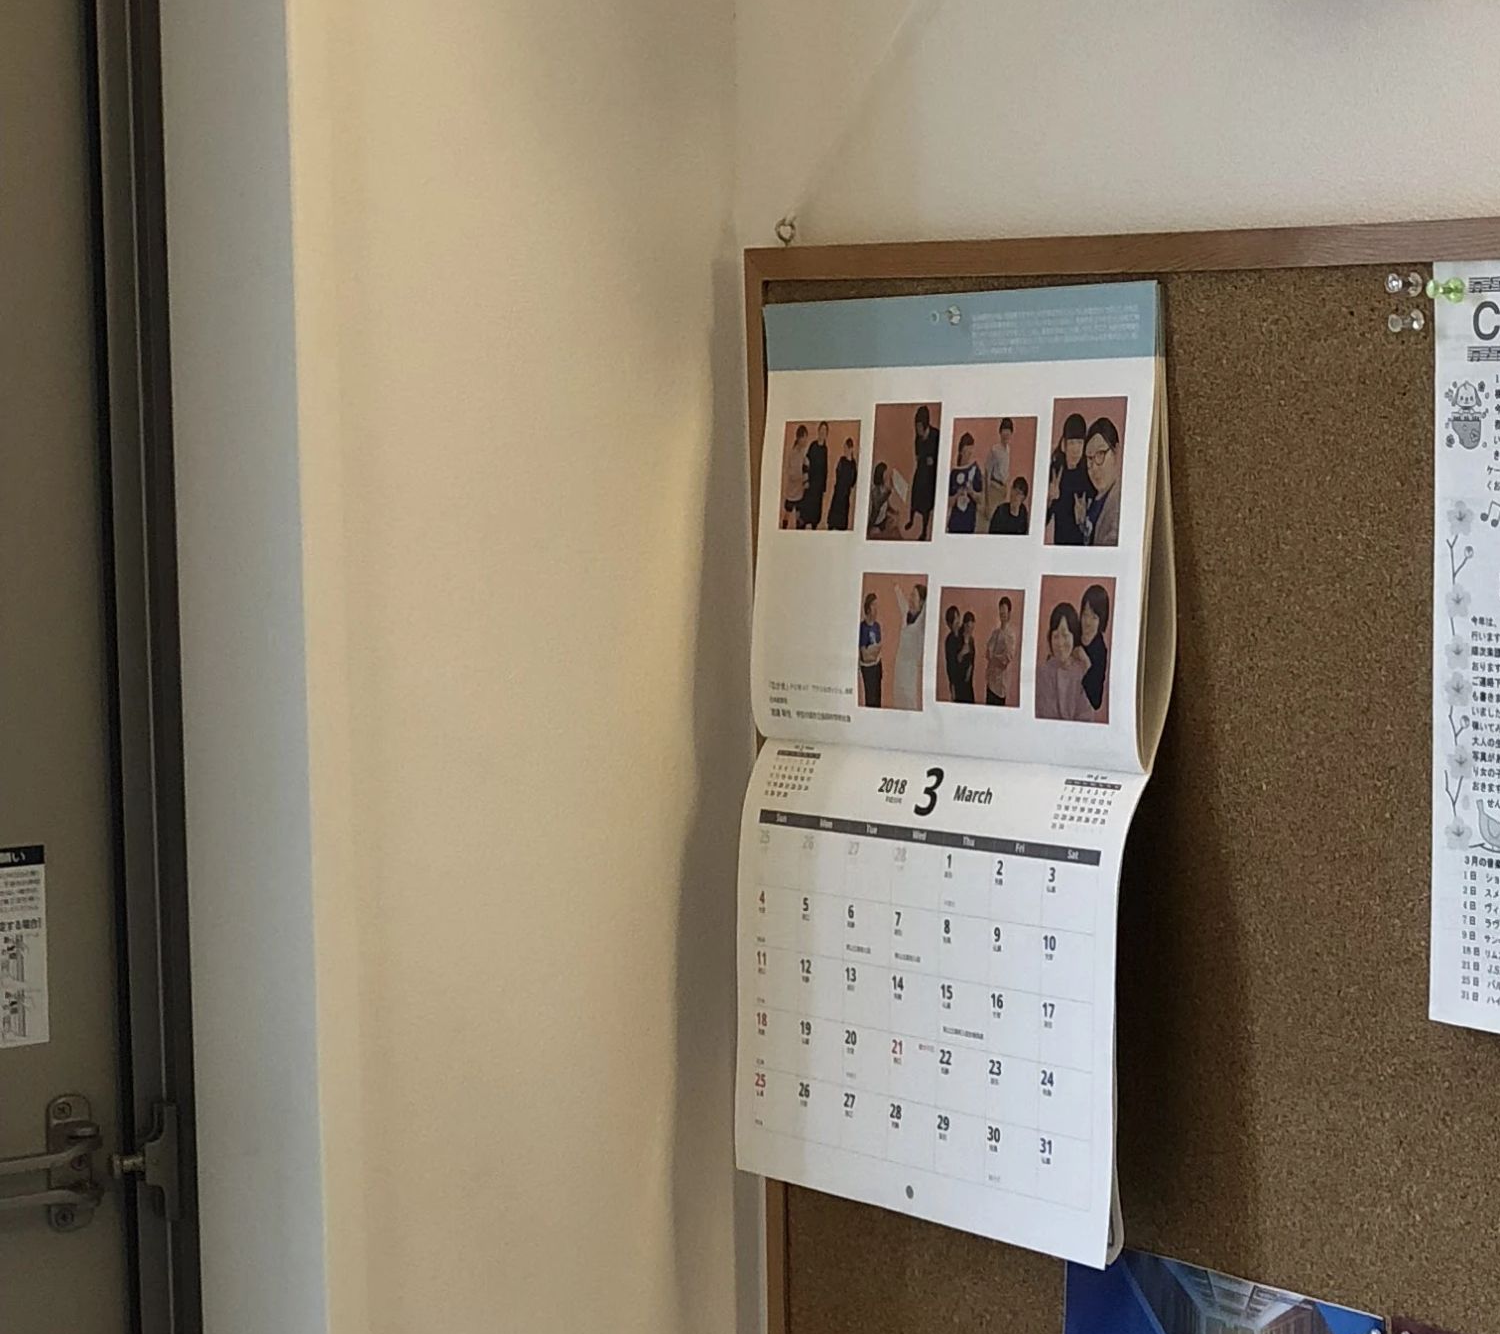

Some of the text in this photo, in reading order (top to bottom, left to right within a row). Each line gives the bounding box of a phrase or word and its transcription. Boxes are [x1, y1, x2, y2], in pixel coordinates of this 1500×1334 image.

[878, 767, 993, 816] 2018 3 March
[946, 854, 1056, 883] 1 2 3
[963, 836, 975, 847] Thu
[1016, 843, 1025, 853] Fri
[1067, 850, 1079, 860] Sat
[759, 891, 1056, 951] 4 5 6 7 8 9 10
[756, 951, 1055, 1019] 11 12 13 14 15 16 17
